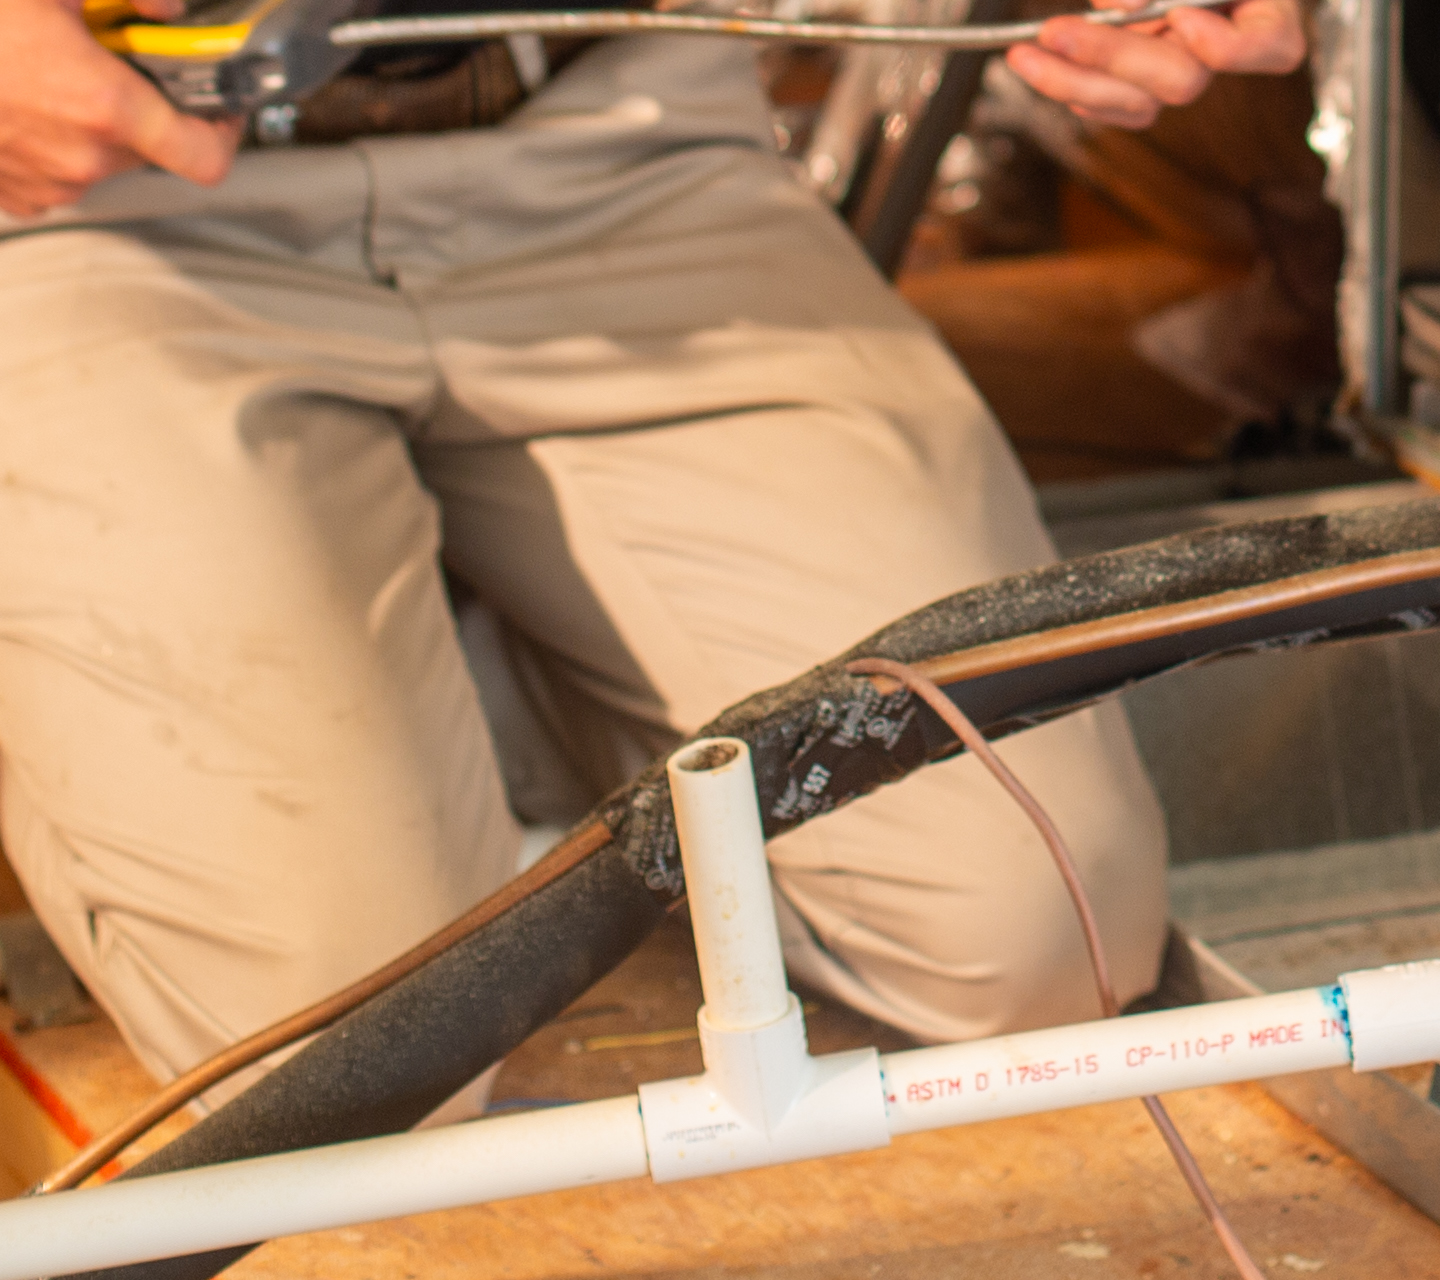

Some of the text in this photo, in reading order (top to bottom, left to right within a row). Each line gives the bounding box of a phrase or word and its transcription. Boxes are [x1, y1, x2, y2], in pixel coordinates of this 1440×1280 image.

[906, 1077, 963, 1104] ASTM
[974, 1071, 990, 1093] D
[1003, 1053, 1100, 1089] 1785-15
[1124, 1032, 1235, 1072] CP-110-P
[1247, 1021, 1304, 1049] MADE
